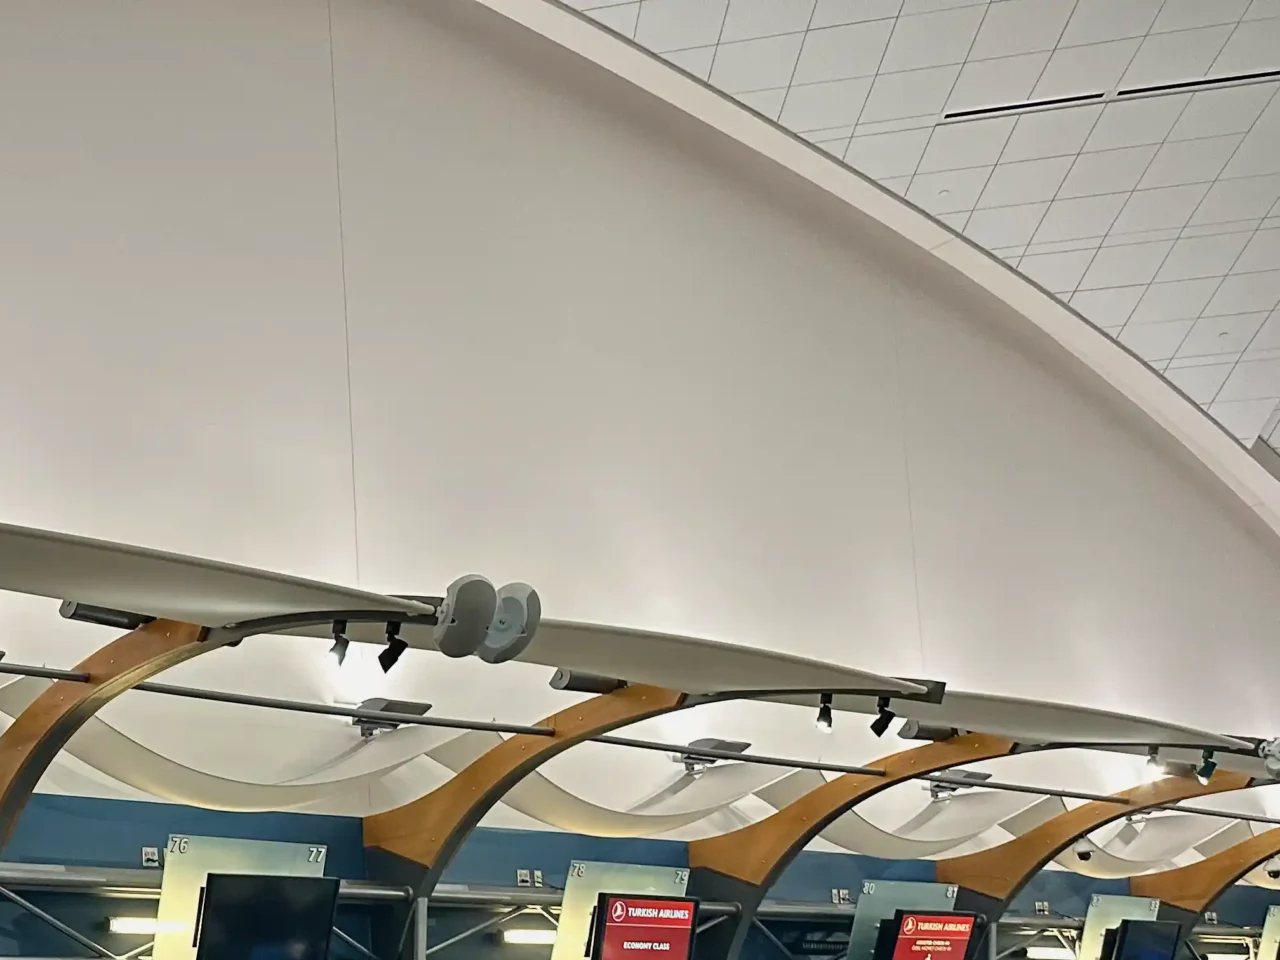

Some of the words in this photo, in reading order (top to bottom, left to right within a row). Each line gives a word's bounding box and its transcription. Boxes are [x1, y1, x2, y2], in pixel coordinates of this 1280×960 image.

[170, 837, 189, 854] 76
[308, 847, 325, 862] 77
[572, 864, 586, 877] 78
[675, 871, 689, 884] 79
[863, 882, 875, 895] 80
[947, 886, 958, 898] 81
[628, 907, 658, 917] TURKISH
[659, 909, 689, 919] AIRLINES
[623, 941, 652, 950] ECONOMY
[653, 942, 670, 950] CLASS
